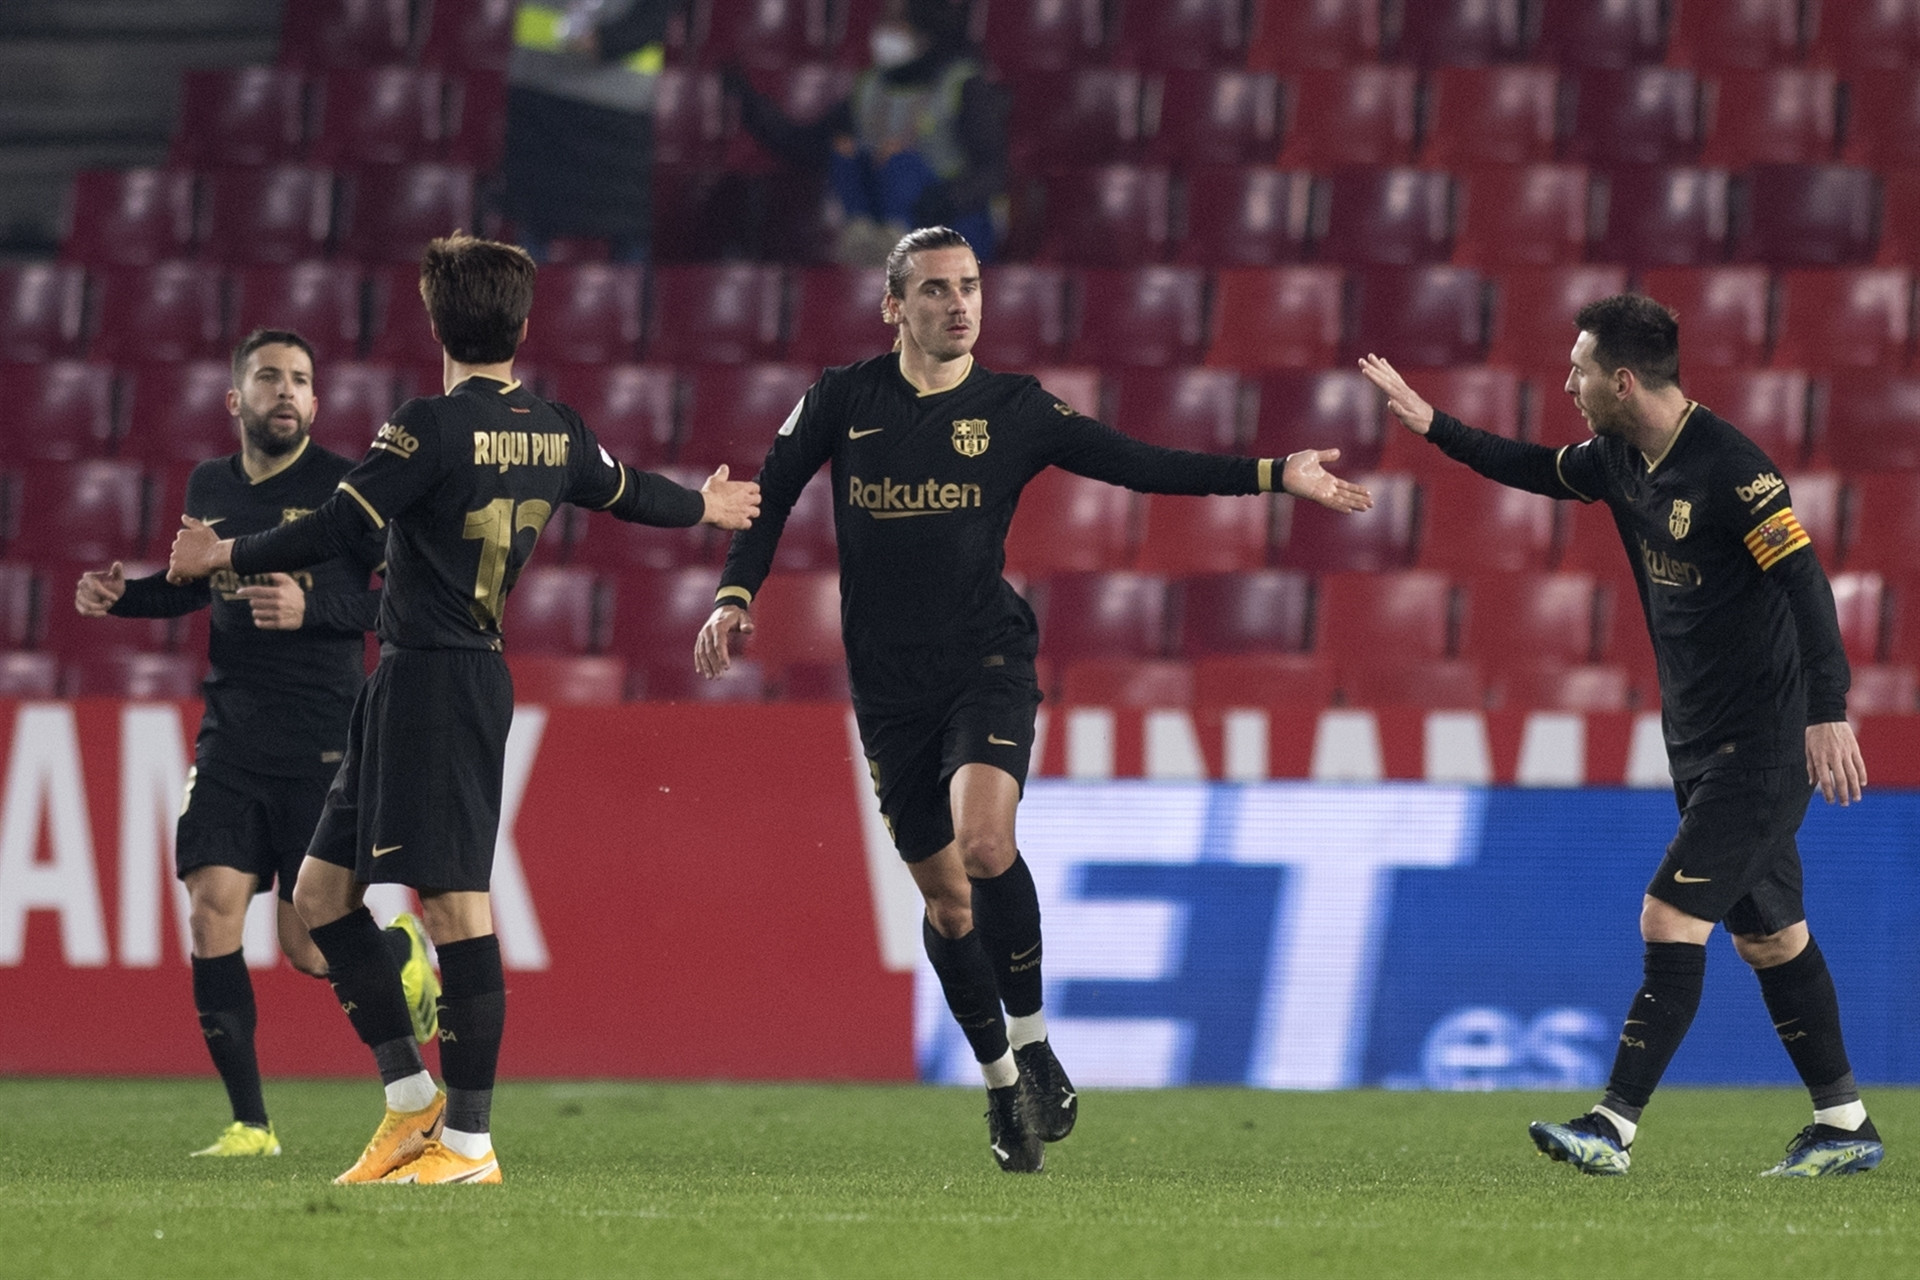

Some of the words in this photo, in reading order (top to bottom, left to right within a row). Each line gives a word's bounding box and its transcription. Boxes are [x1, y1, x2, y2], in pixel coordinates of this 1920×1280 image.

[473, 430, 529, 474] RIQUI
[849, 475, 982, 509] Rakuten
[1641, 539, 1702, 586] kuten
